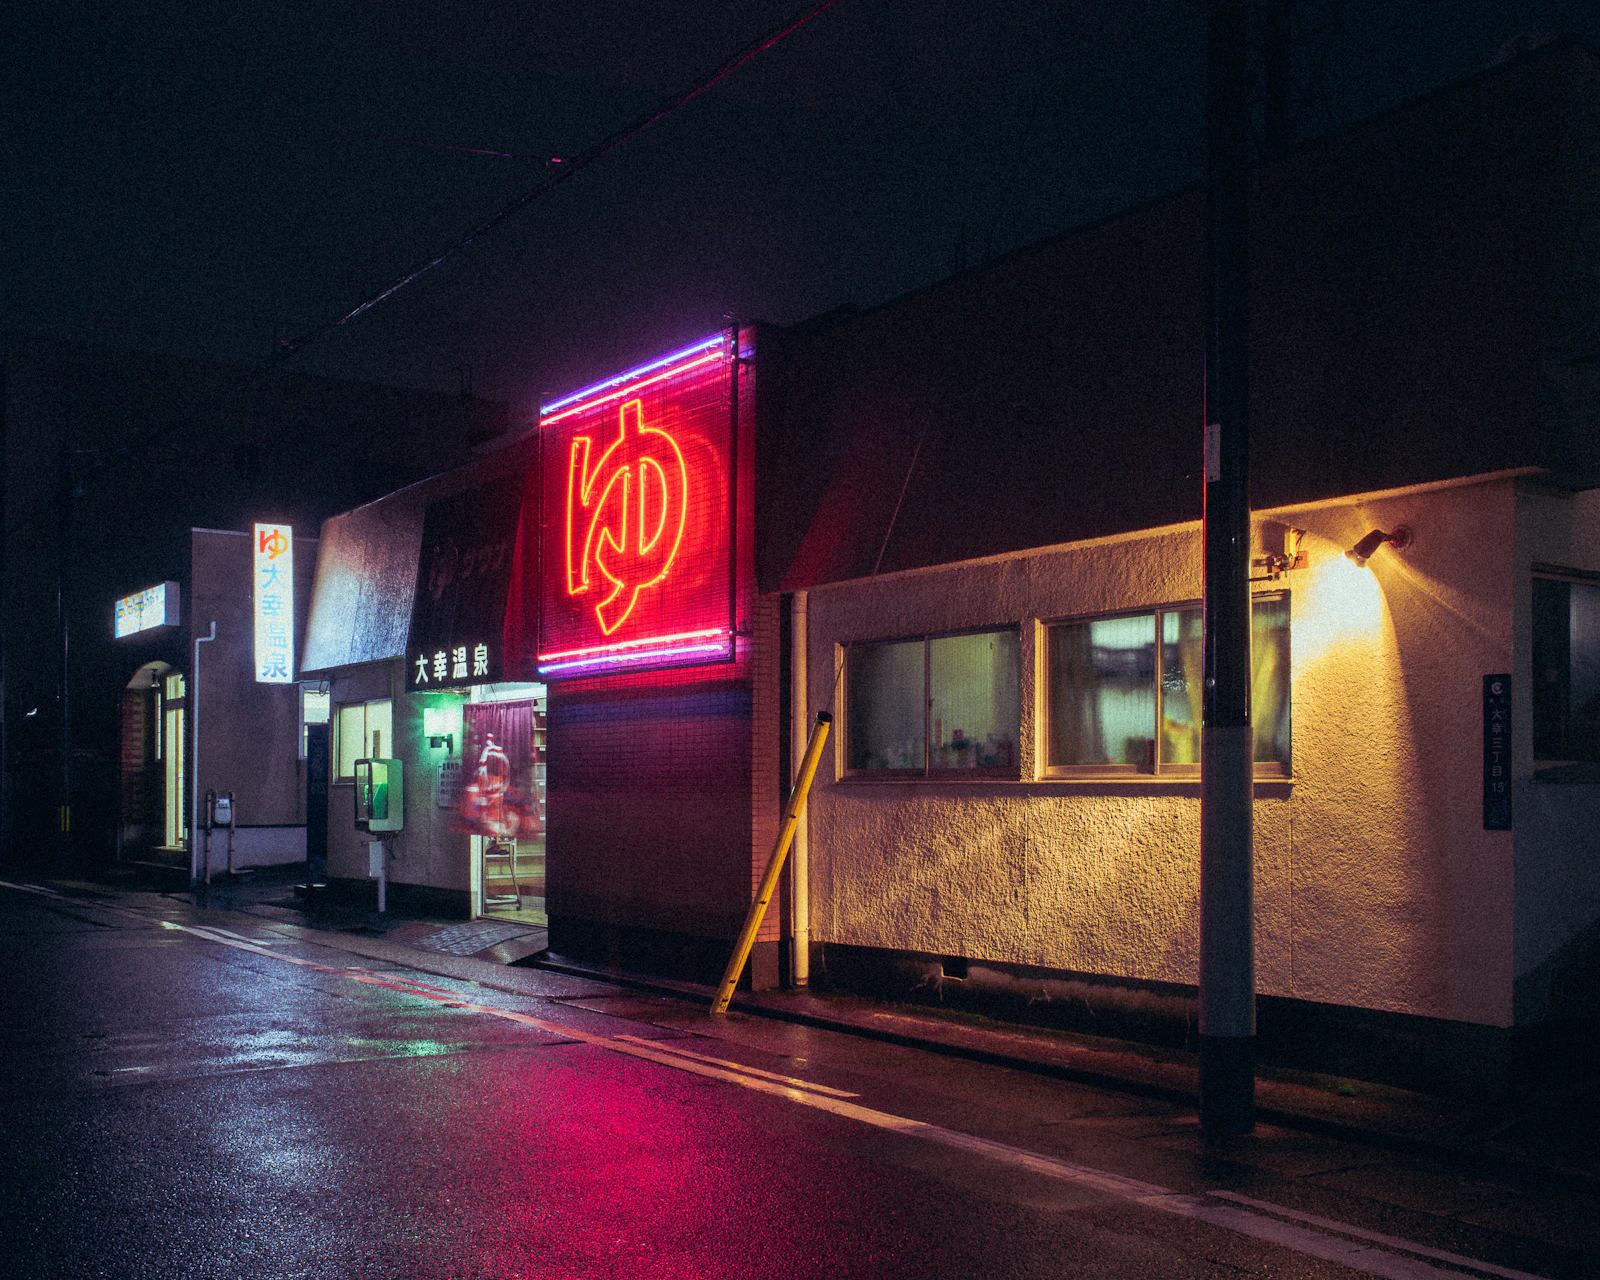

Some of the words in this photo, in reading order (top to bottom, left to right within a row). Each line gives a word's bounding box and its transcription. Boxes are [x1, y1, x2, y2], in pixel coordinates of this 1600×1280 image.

[566, 398, 688, 636] ゆ
[415, 642, 488, 685] 大幸温泉
